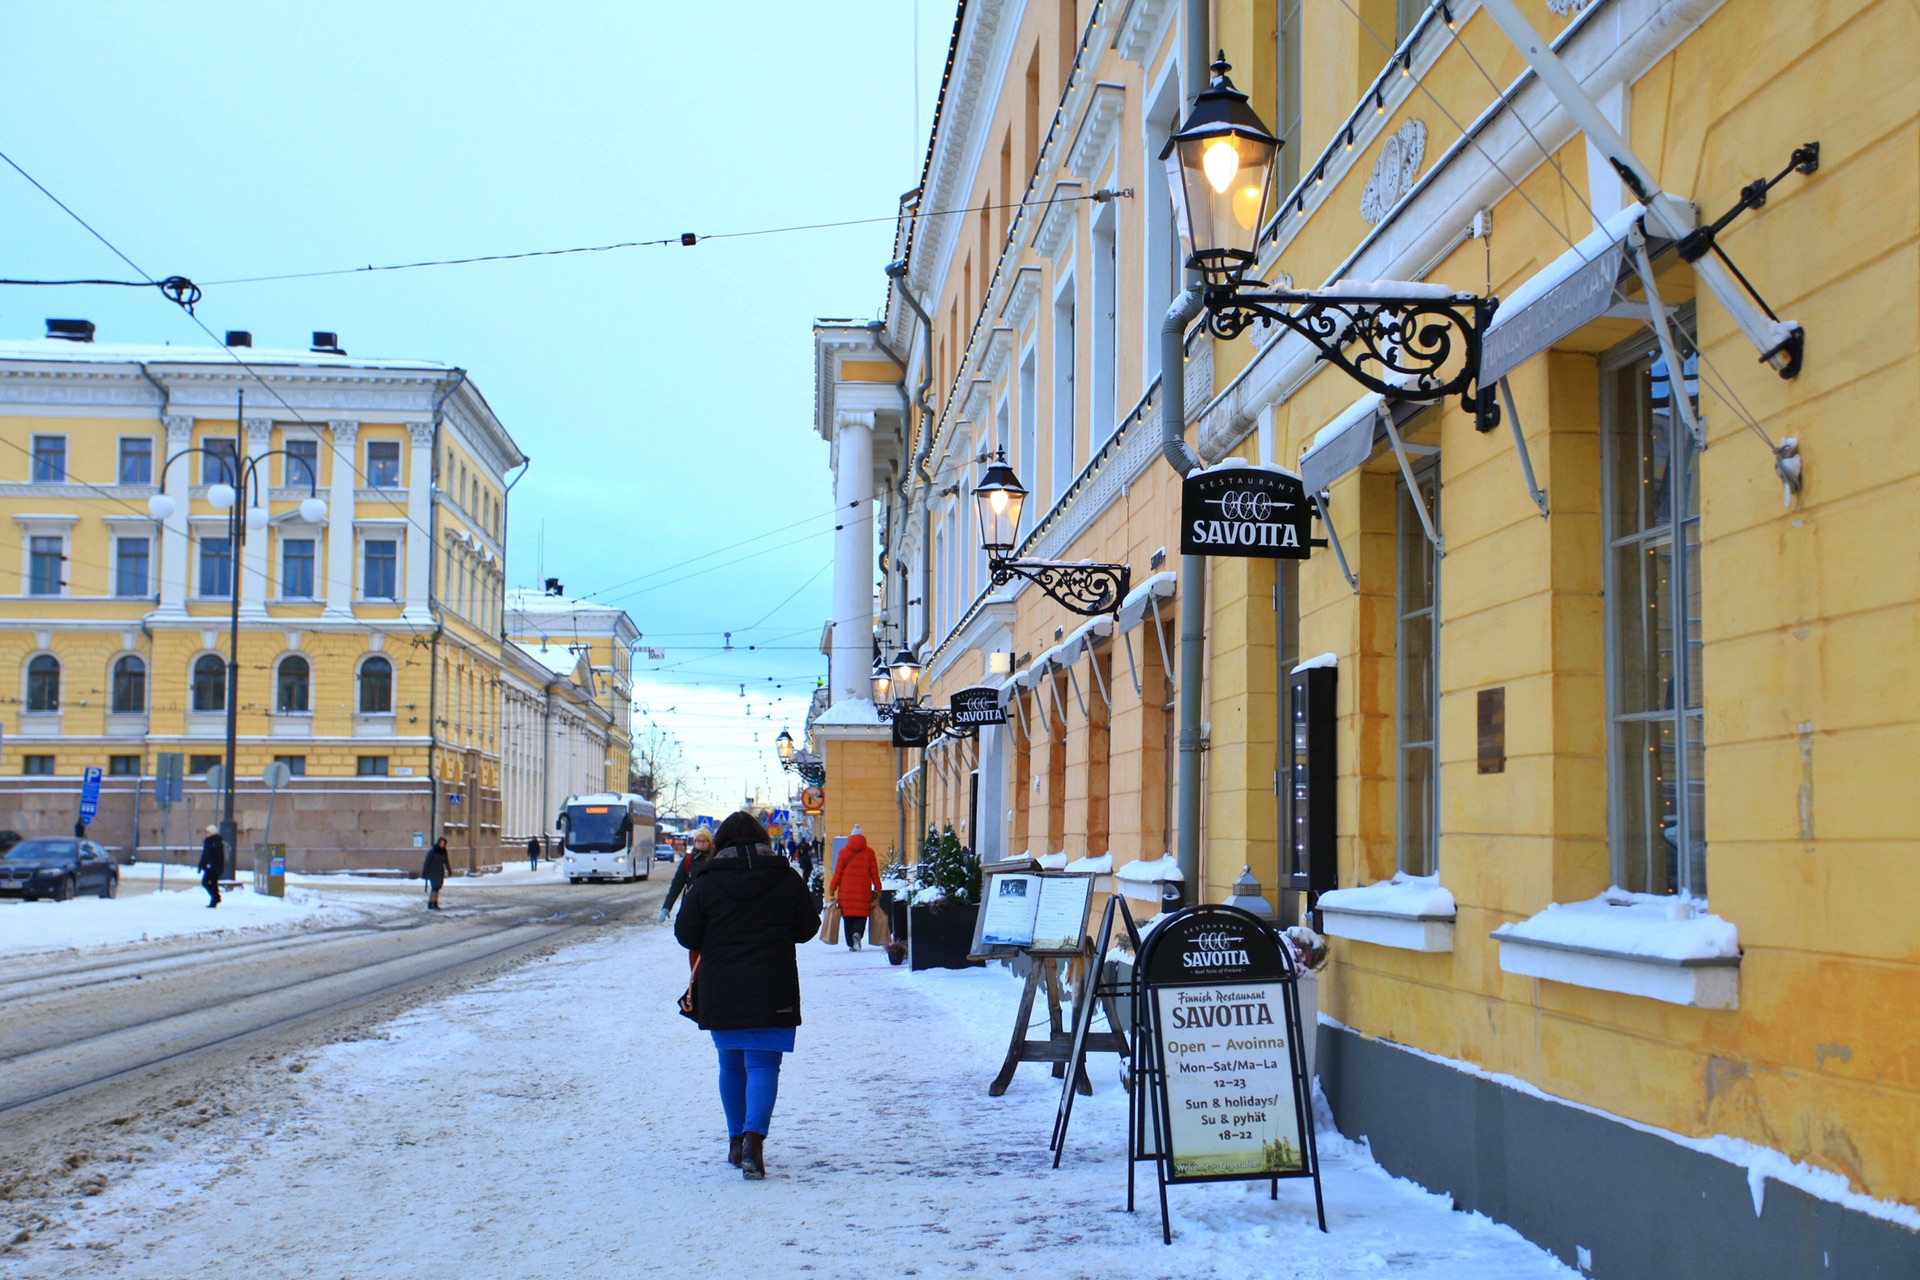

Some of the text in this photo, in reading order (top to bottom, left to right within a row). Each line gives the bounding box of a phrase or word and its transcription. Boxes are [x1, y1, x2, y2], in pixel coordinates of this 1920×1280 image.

[1536, 251, 1620, 332] RESTAURANT
[1199, 477, 1296, 493] RESTAURANT
[1192, 520, 1300, 548] SAVOTTA
[956, 710, 1003, 723] SAVOTTA
[1183, 924, 1243, 934] RESTAURANT
[1182, 950, 1251, 968] SAVOTTA
[1177, 990, 1265, 1005] Finnish Restaurant
[1172, 1003, 1275, 1029] SAVOTTA
[1167, 1041, 1206, 1056] Open
[1226, 1036, 1285, 1051] Avoinna
[1185, 1094, 1278, 1110] Sun & holidays/
[1201, 1111, 1267, 1127] Su & pyhät
[1177, 1163, 1209, 1171] Welcome
